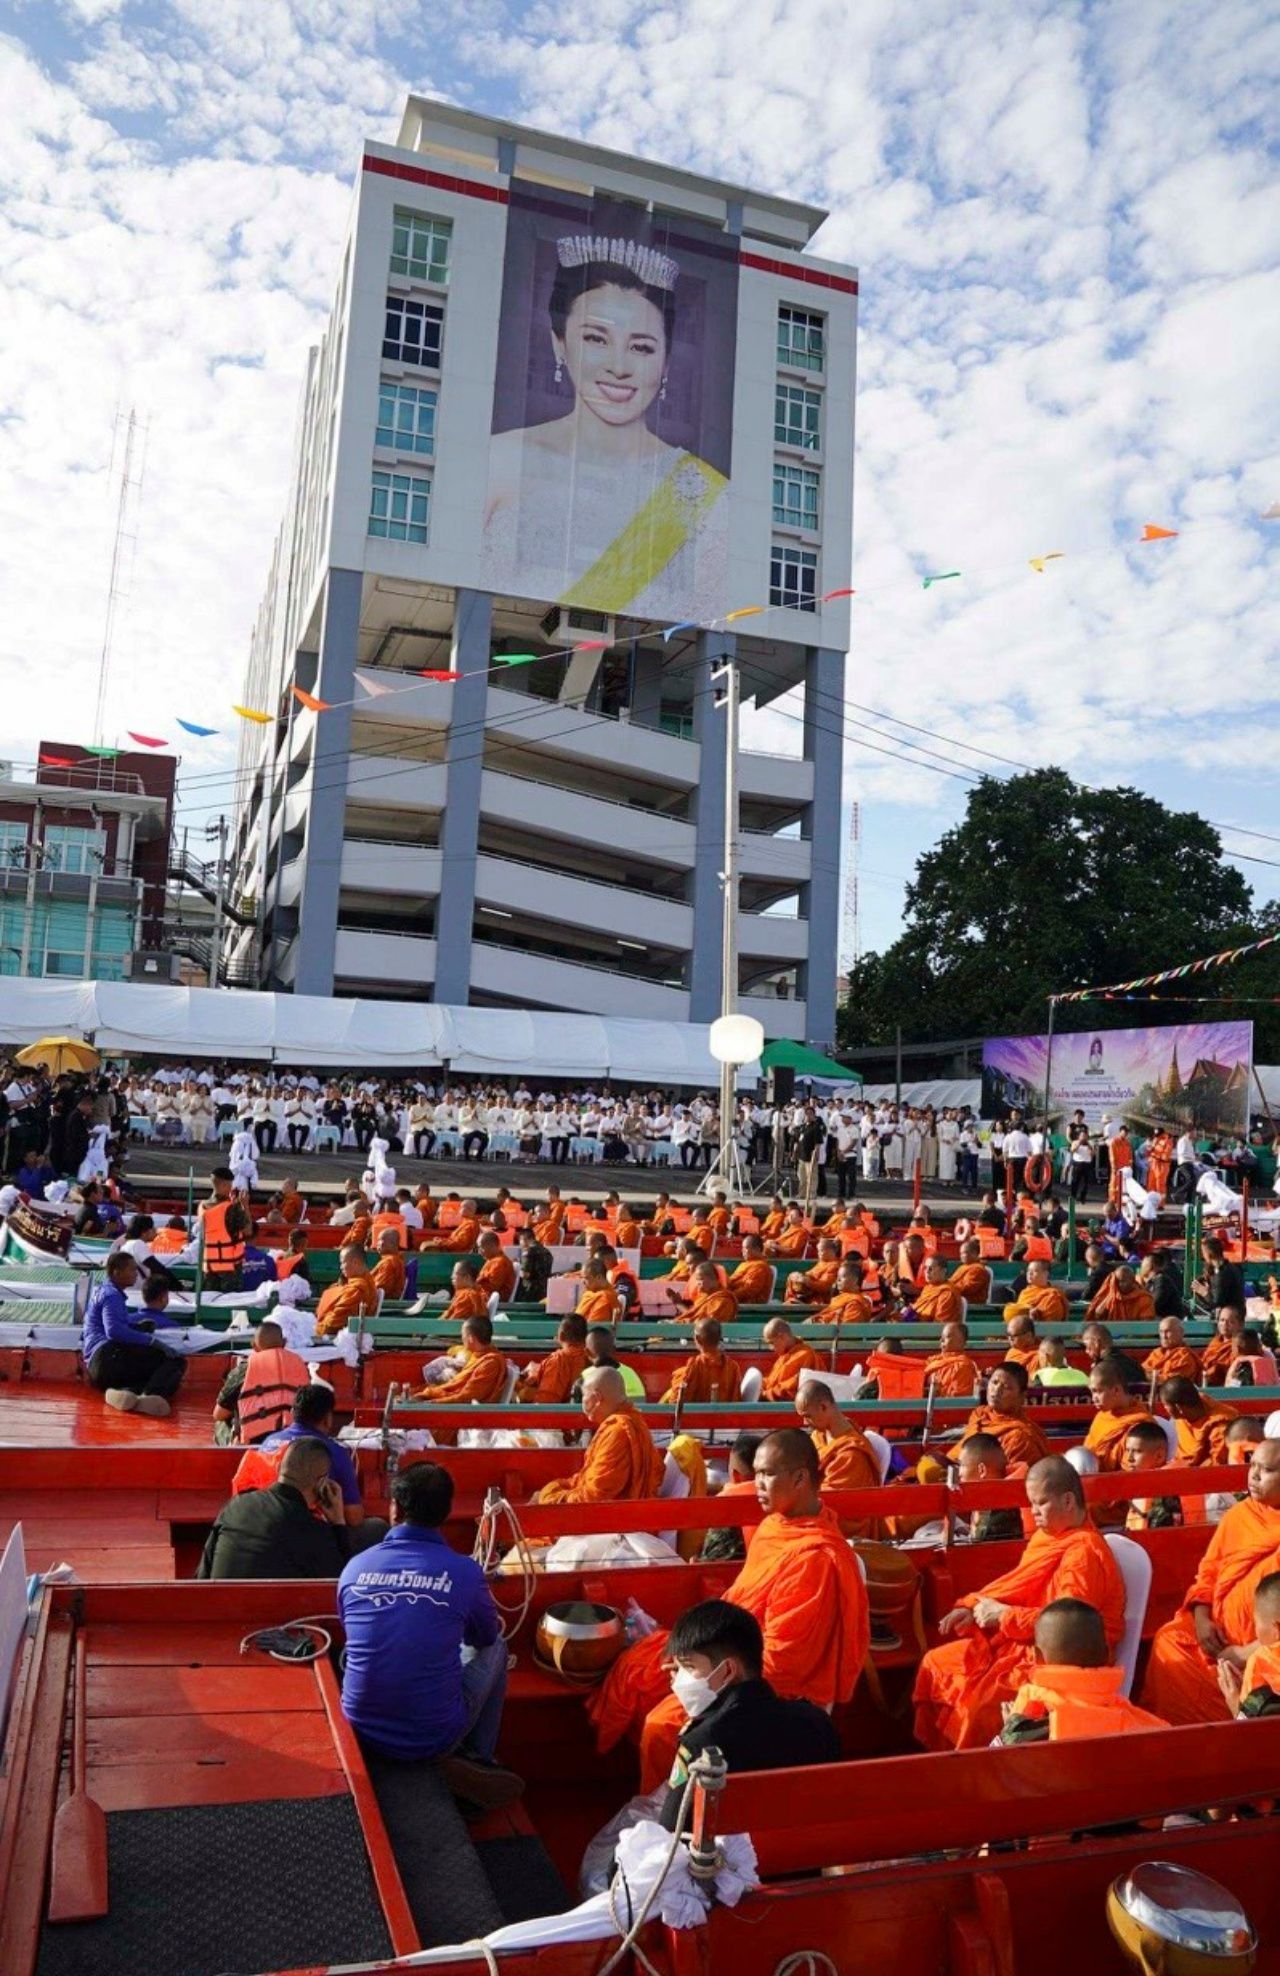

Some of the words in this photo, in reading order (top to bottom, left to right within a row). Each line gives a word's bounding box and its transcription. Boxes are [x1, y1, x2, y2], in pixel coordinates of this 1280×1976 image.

[355, 1569, 453, 1593] ครอบครัวขนส่ง
